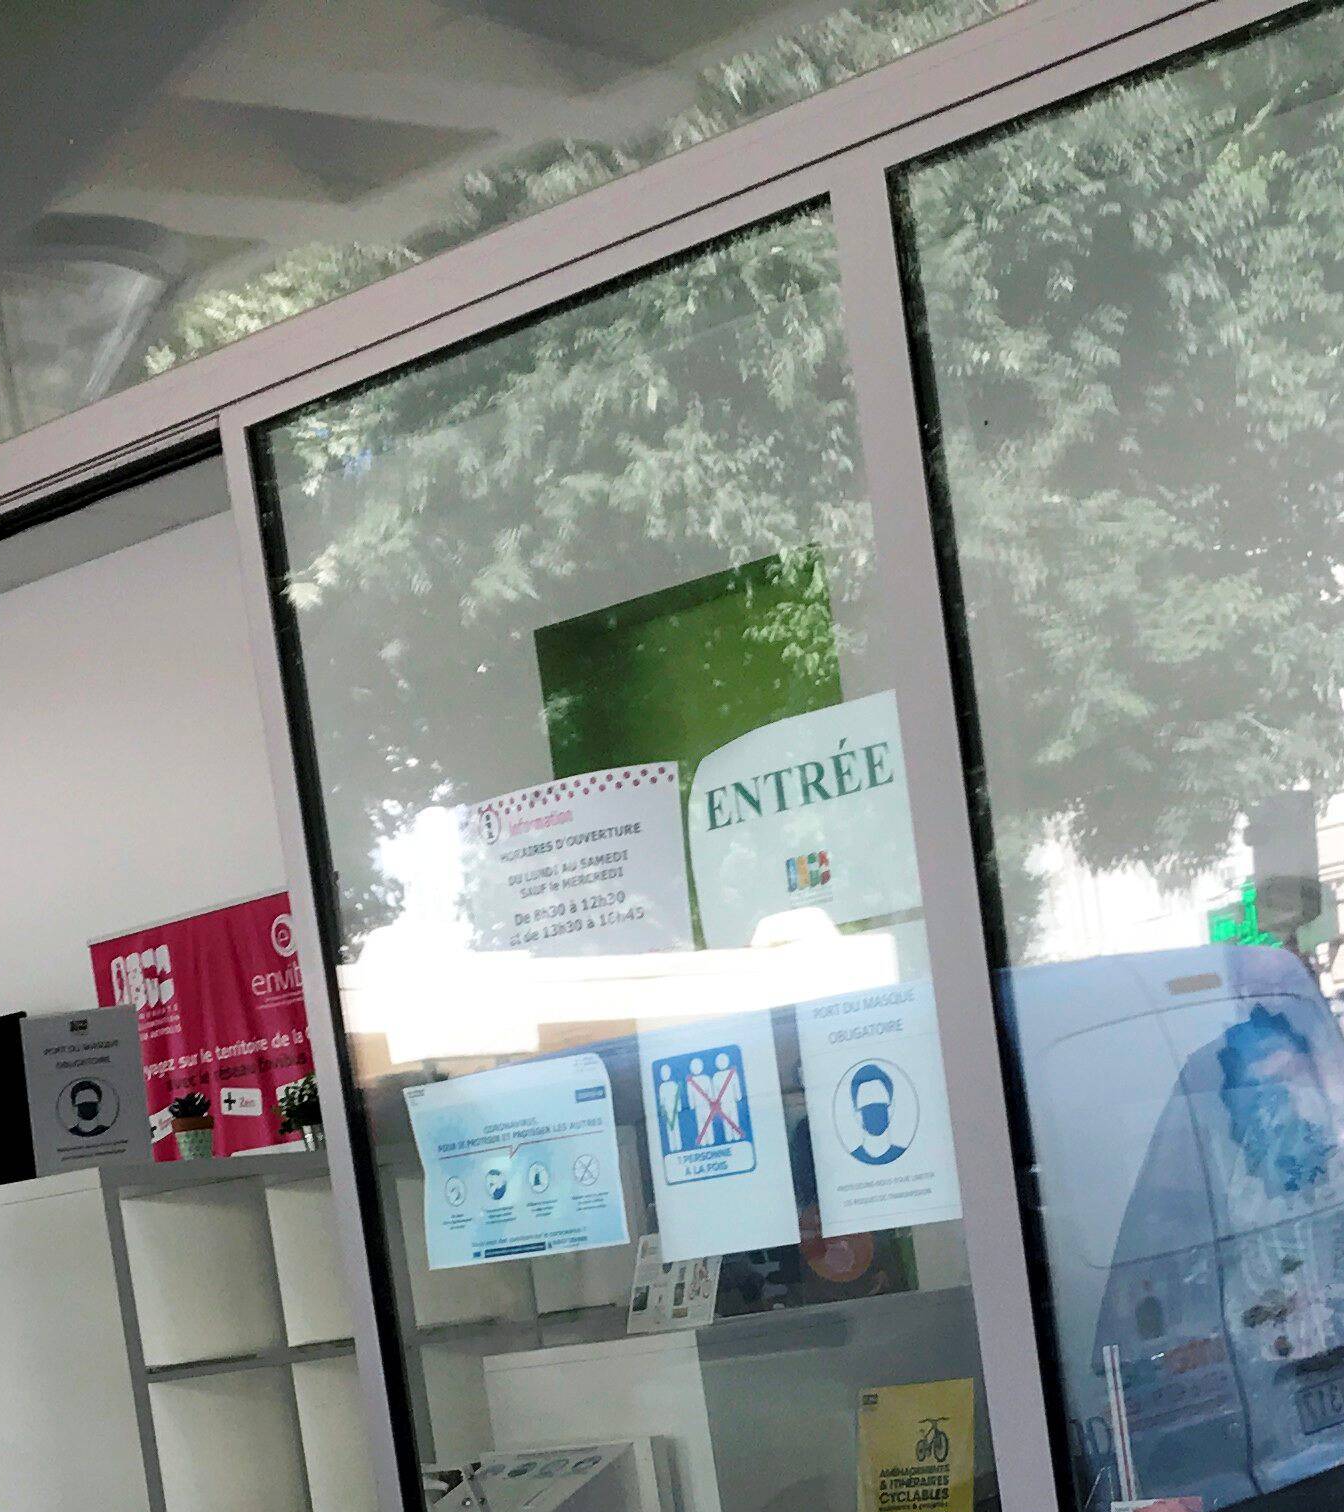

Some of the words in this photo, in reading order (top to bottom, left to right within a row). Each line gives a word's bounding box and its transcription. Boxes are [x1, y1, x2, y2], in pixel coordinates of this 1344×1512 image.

[705, 737, 894, 831] ENTRÉE
[579, 849, 629, 871] SAMEDI
[215, 1038, 269, 1060] territoire
[270, 1032, 291, 1049] de
[878, 1487, 950, 1505] CYCLABLES
